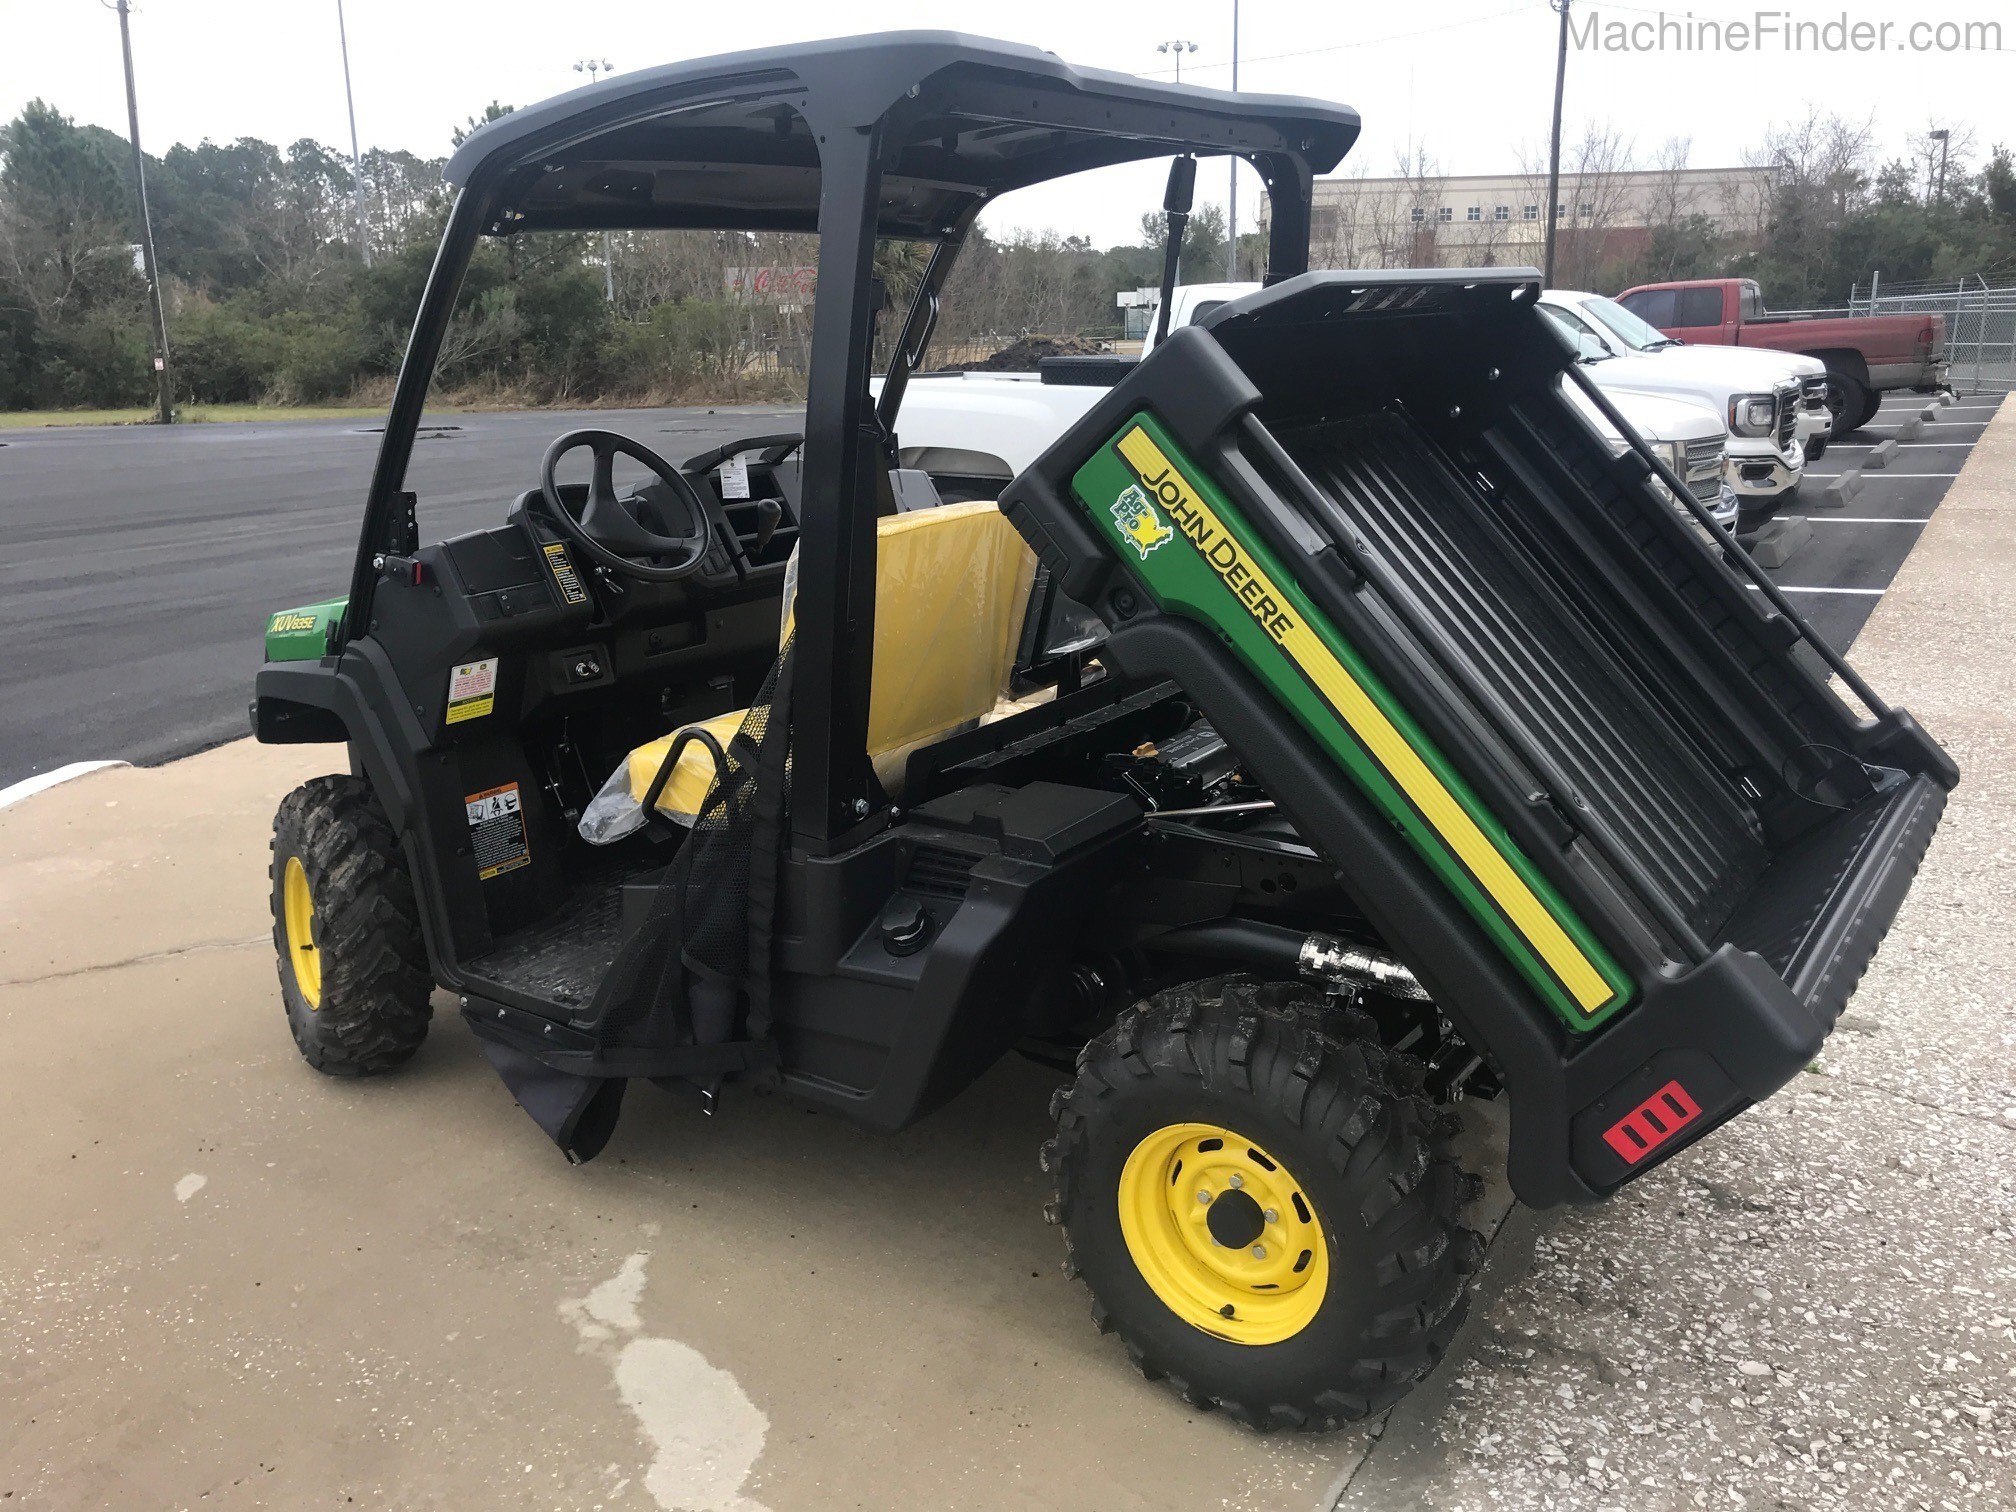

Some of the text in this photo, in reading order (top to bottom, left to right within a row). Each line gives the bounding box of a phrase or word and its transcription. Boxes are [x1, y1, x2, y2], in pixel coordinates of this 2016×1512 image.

[1113, 501, 1139, 530] Pro
[1122, 489, 1149, 518] Ag-
[1142, 468, 1294, 640] JOHN DEERE
